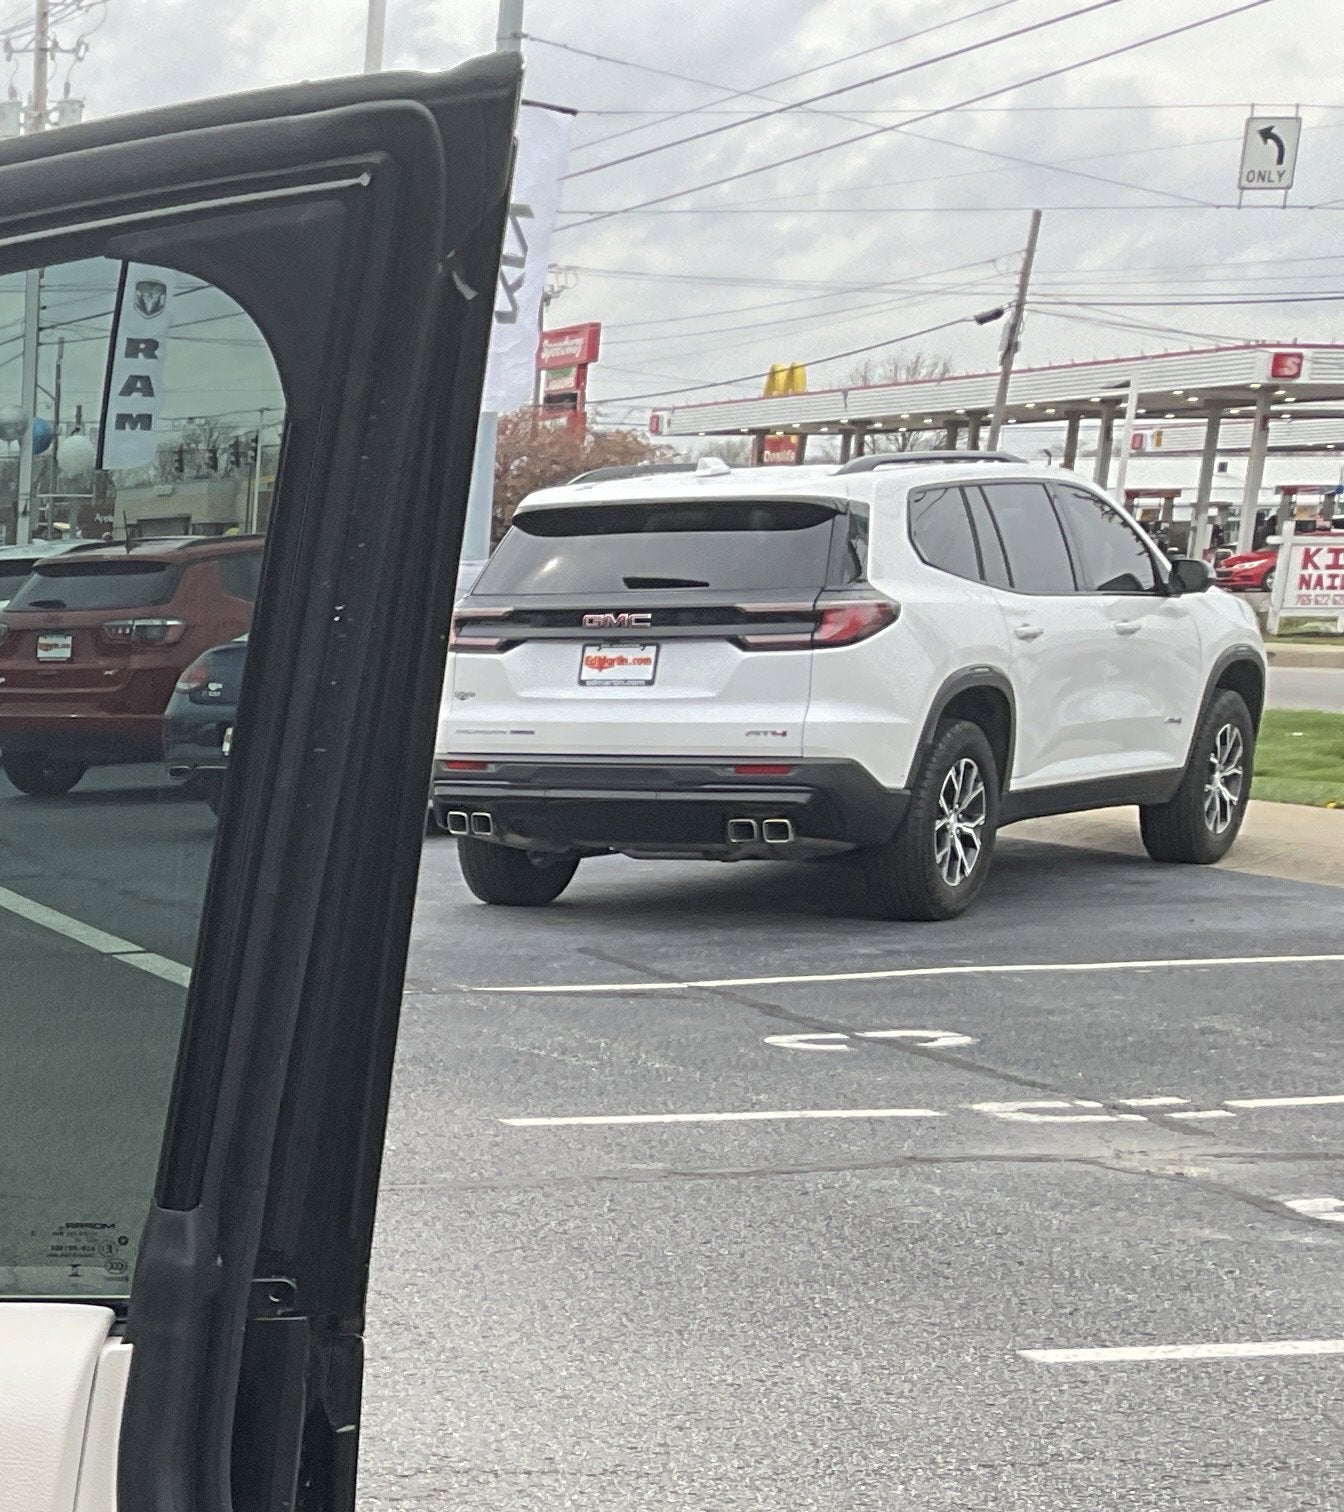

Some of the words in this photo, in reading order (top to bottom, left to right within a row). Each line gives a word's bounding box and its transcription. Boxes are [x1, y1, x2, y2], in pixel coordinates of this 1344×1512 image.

[1246, 169, 1286, 183] ONLY
[541, 336, 585, 364] Speedway
[115, 337, 160, 431] RAM
[582, 613, 652, 629] GMC
